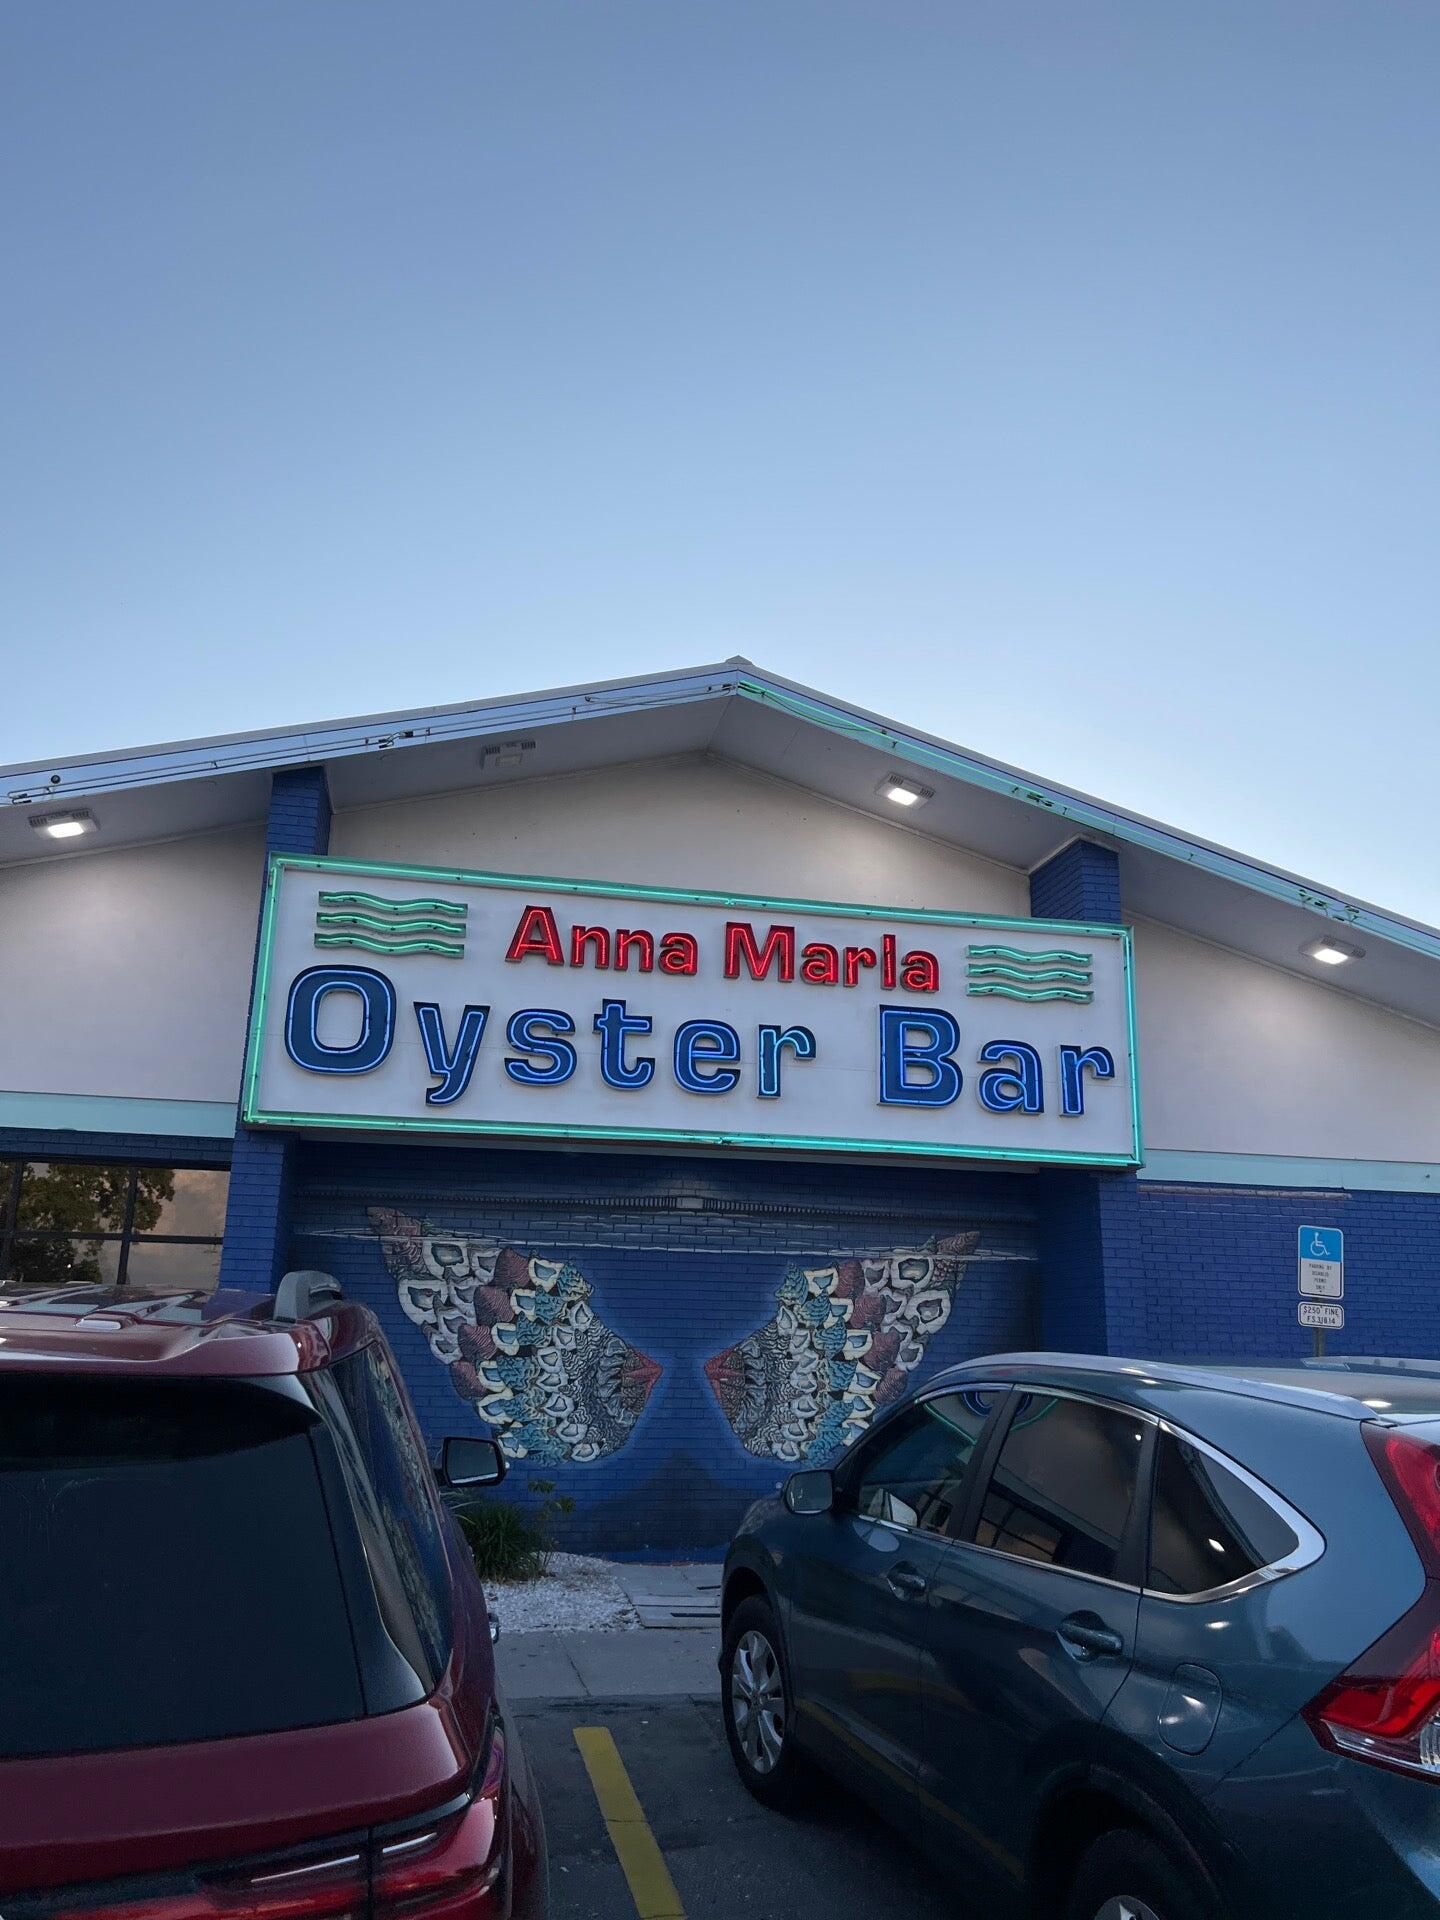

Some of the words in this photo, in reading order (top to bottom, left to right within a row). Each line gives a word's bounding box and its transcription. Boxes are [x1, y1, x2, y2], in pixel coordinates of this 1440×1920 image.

[505, 905, 698, 976] Anna
[284, 964, 817, 1106] Oyster
[877, 1004, 1116, 1118] Bar
[1303, 1305, 1321, 1315] $250
[1324, 1307, 1339, 1316] FINE
